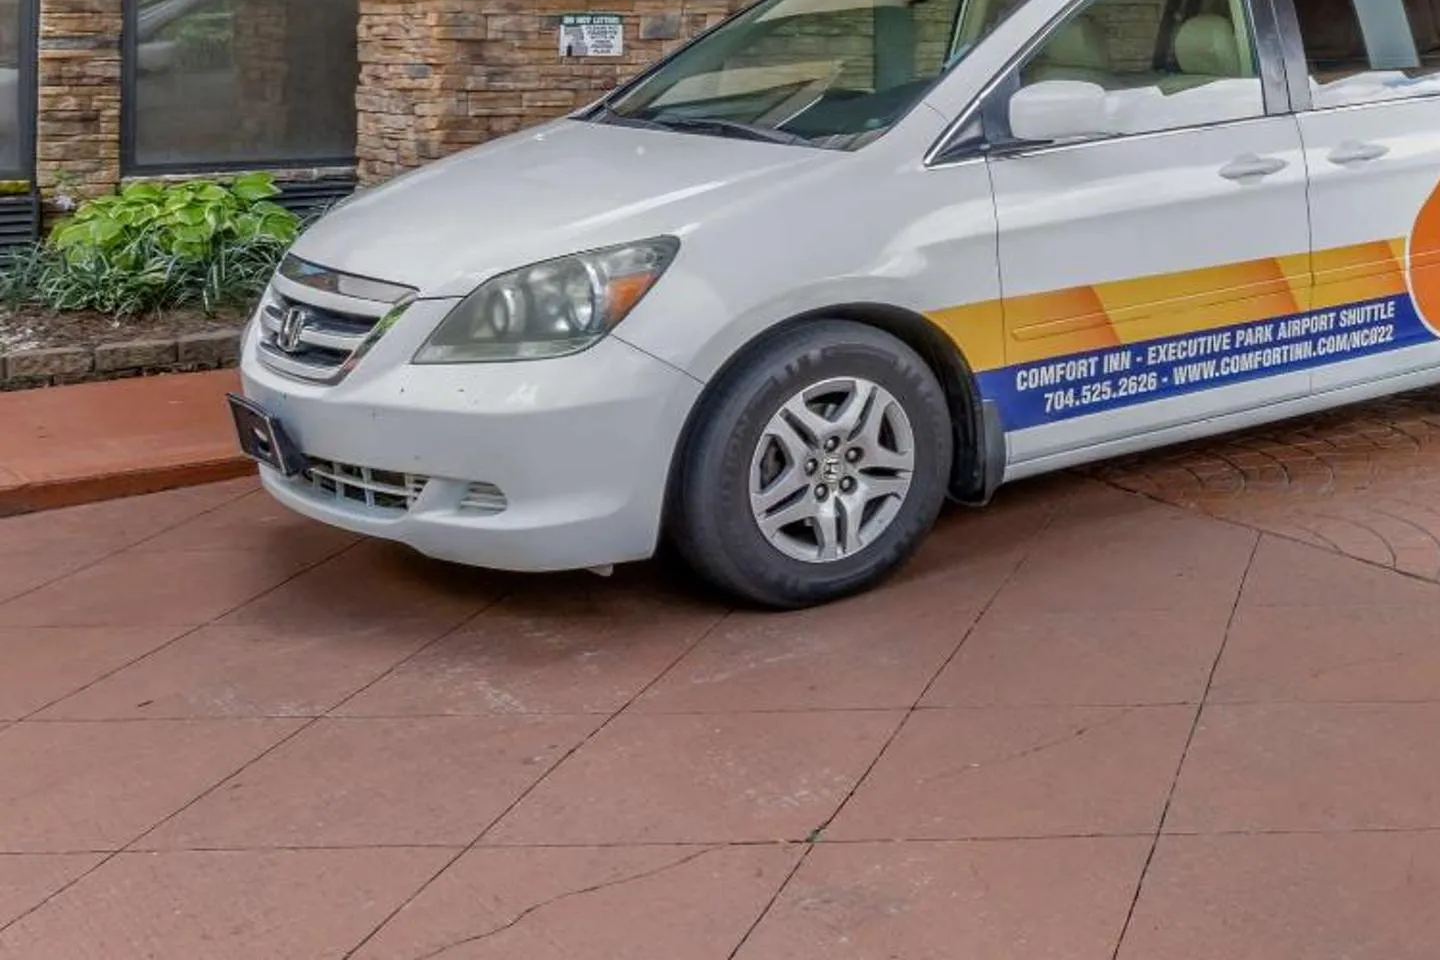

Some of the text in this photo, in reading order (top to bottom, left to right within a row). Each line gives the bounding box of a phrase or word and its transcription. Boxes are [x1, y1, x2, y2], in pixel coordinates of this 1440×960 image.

[1016, 358, 1096, 391] COMFORT
[1103, 351, 1131, 379] INN
[1147, 332, 1231, 366] EXECUTIVE
[1235, 324, 1273, 349] PARK
[1277, 314, 1337, 339] AIRPORT
[1339, 301, 1395, 328] SHUTTLE
[1044, 372, 1157, 413] 704.525.2626
